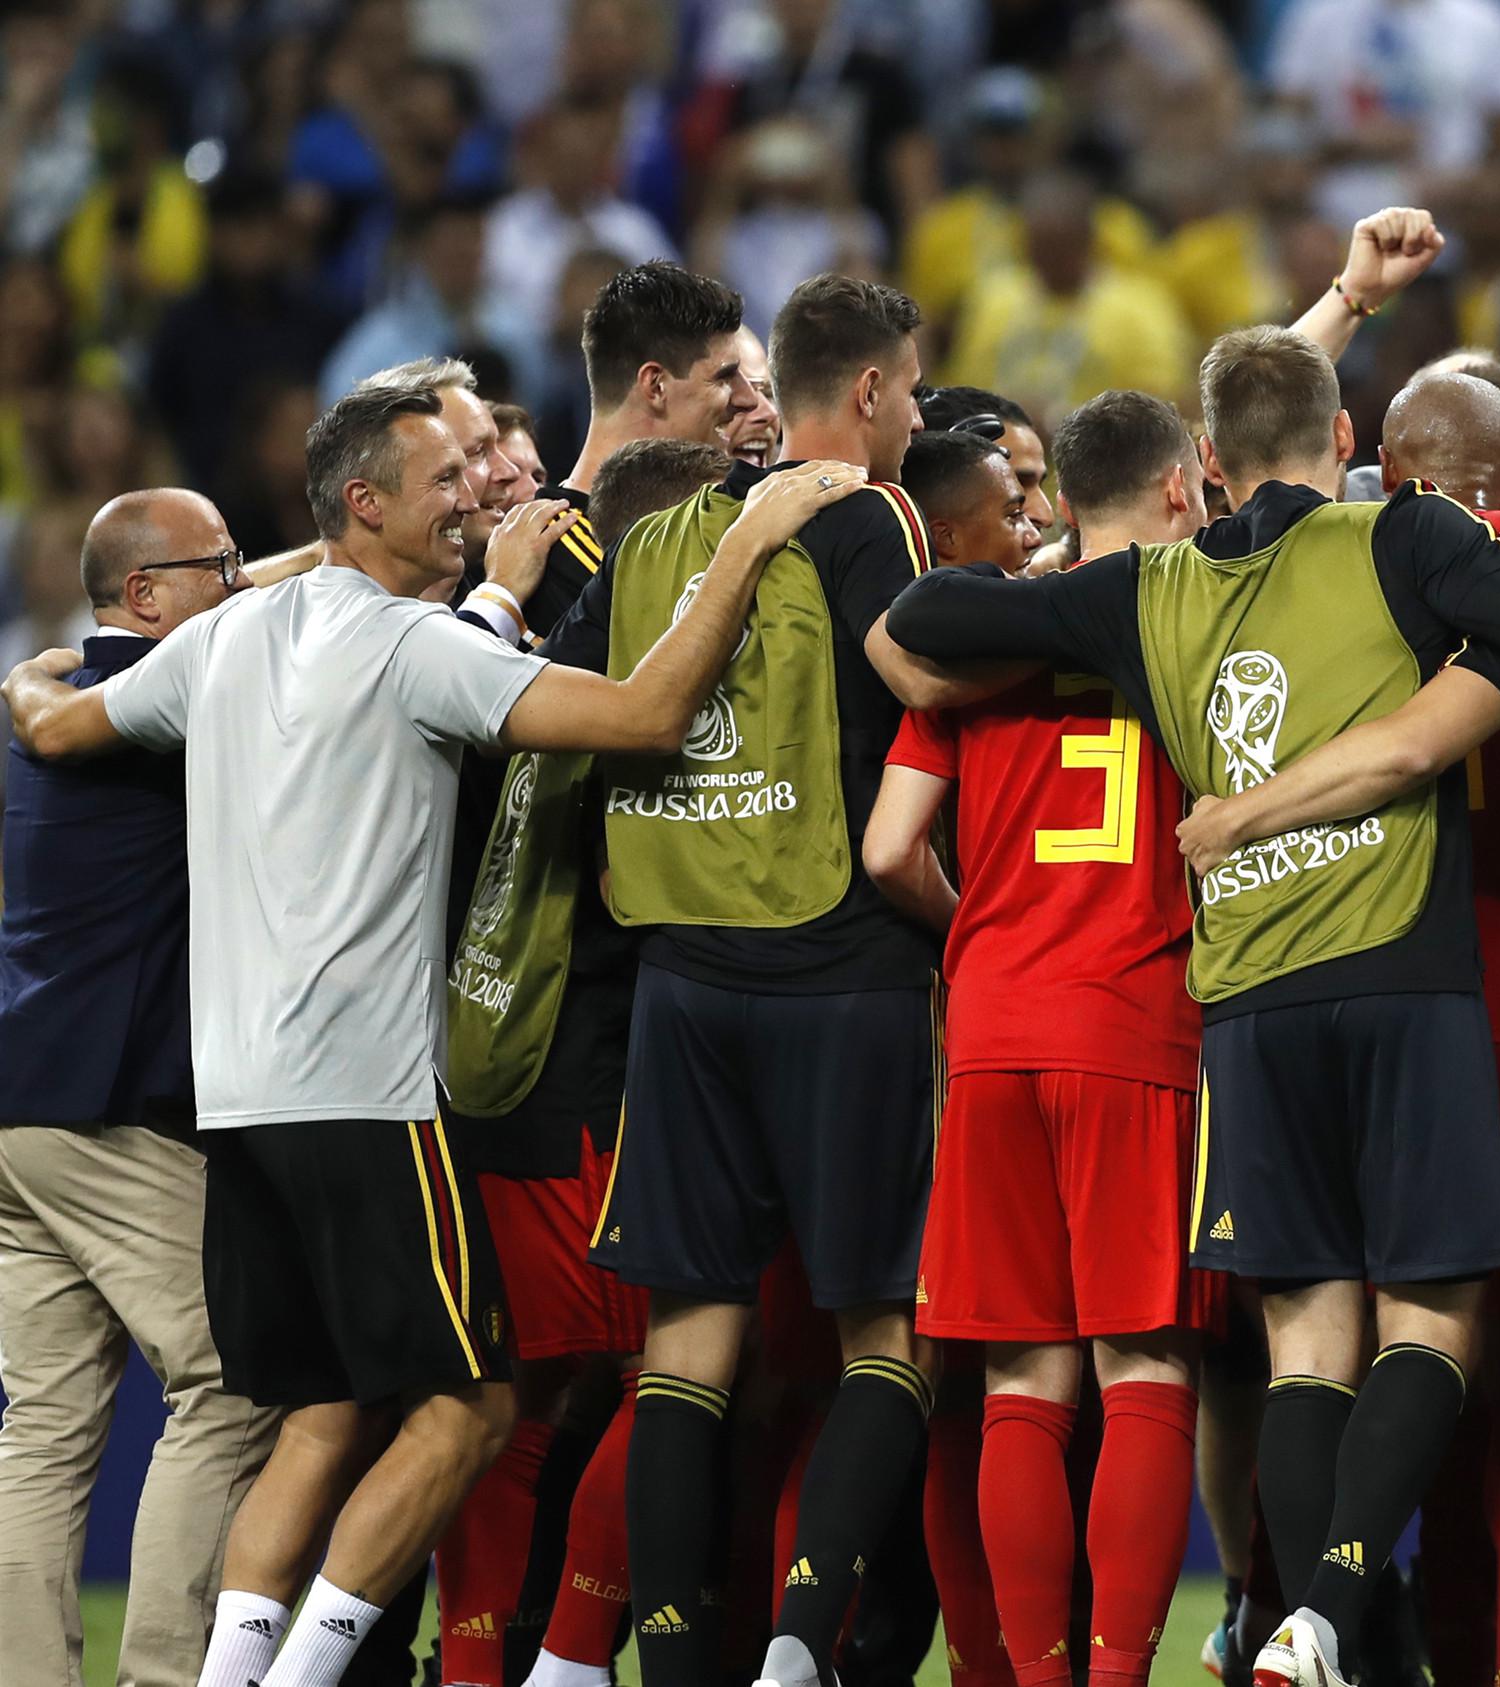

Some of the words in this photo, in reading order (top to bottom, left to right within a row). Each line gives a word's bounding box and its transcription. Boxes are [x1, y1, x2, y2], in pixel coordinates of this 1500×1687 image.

[740, 770, 765, 785] CUP
[1034, 671, 1141, 865] 3
[607, 786, 732, 822] RUSSIA
[733, 781, 797, 819] 2018
[1202, 848, 1300, 905] USSIA
[1300, 817, 1385, 870] 2018
[1323, 1552, 1366, 1576] adidas
[239, 1622, 273, 1640] adidas
[320, 1619, 357, 1641] adidas
[451, 1626, 497, 1640] adidas
[641, 1622, 689, 1635] adidas
